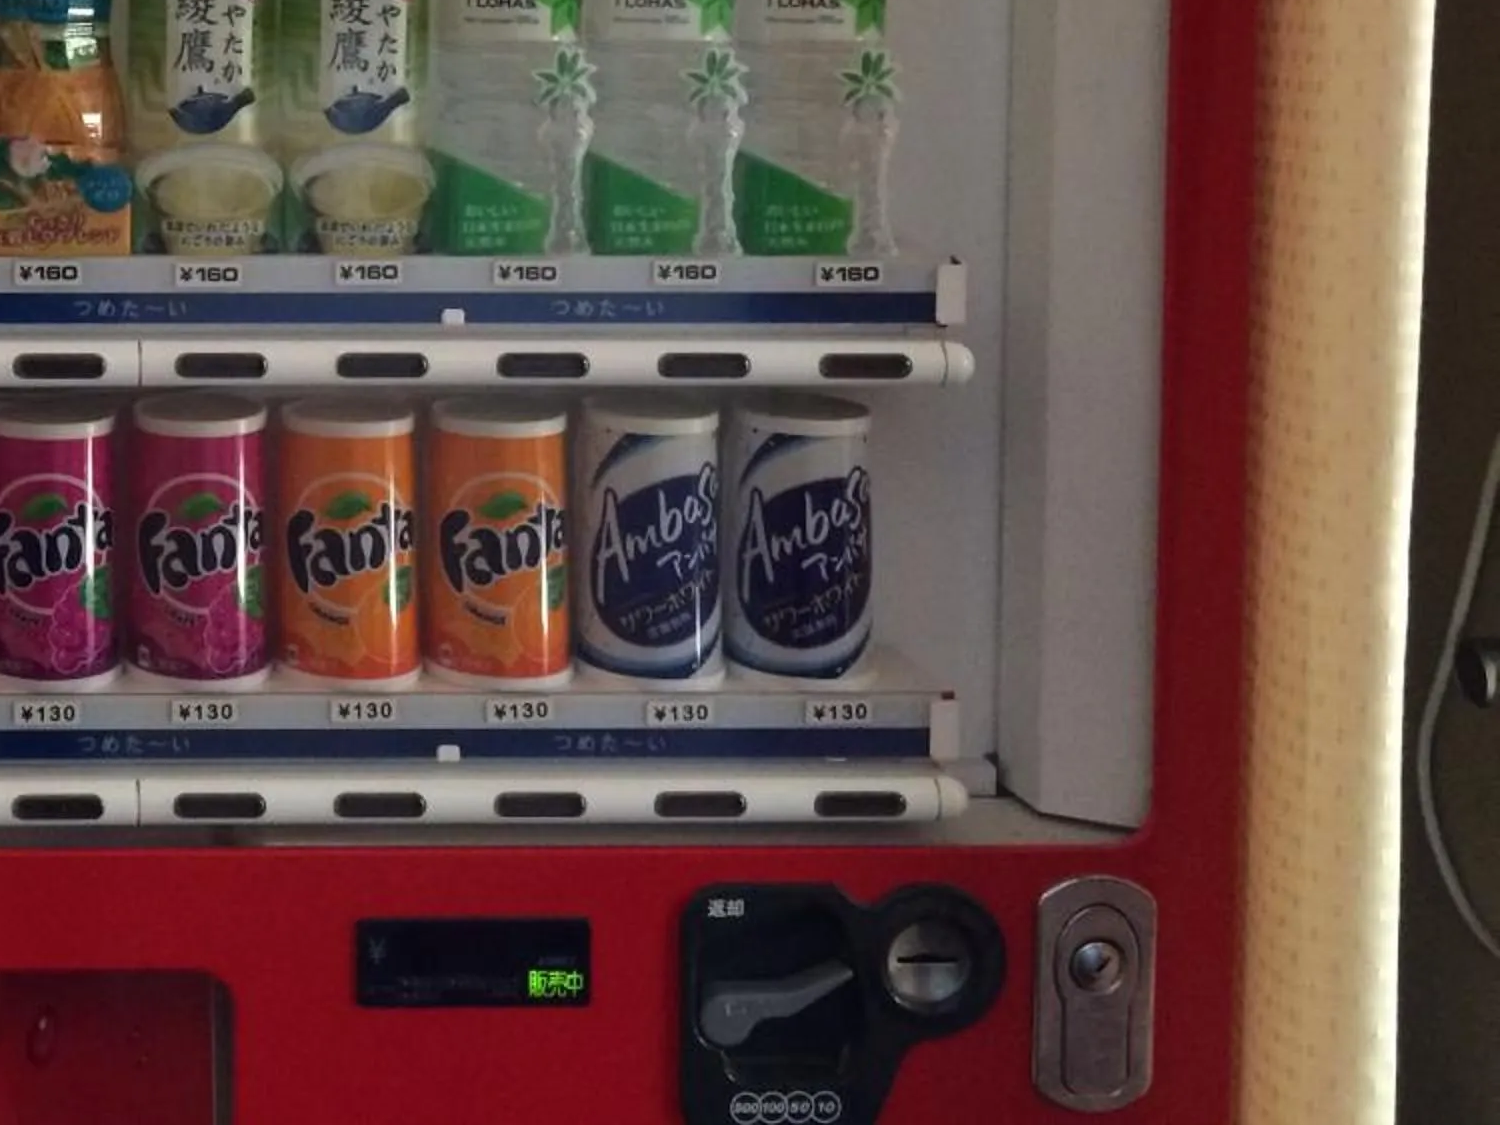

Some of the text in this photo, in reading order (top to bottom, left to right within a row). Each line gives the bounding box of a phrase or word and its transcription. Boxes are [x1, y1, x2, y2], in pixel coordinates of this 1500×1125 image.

[19, 265, 78, 281] ¥160
[180, 266, 239, 282] ¥160
[340, 264, 399, 280] ¥160
[499, 265, 557, 281] ¥160
[658, 264, 717, 280] ¥160
[821, 266, 880, 282] ¥160
[138, 502, 264, 596] Fanta
[287, 502, 414, 594] Fanta
[440, 502, 566, 594] Fanta
[21, 705, 75, 722] ¥130
[179, 703, 233, 721] ¥130
[339, 702, 393, 720] ¥130
[494, 701, 549, 720] ¥130
[654, 704, 709, 722] ¥130
[813, 702, 868, 721] ¥130
[528, 970, 584, 997] 販売中
[762, 1101, 785, 1114] 100
[790, 1101, 811, 1114] 50
[818, 1101, 836, 1114] 10
